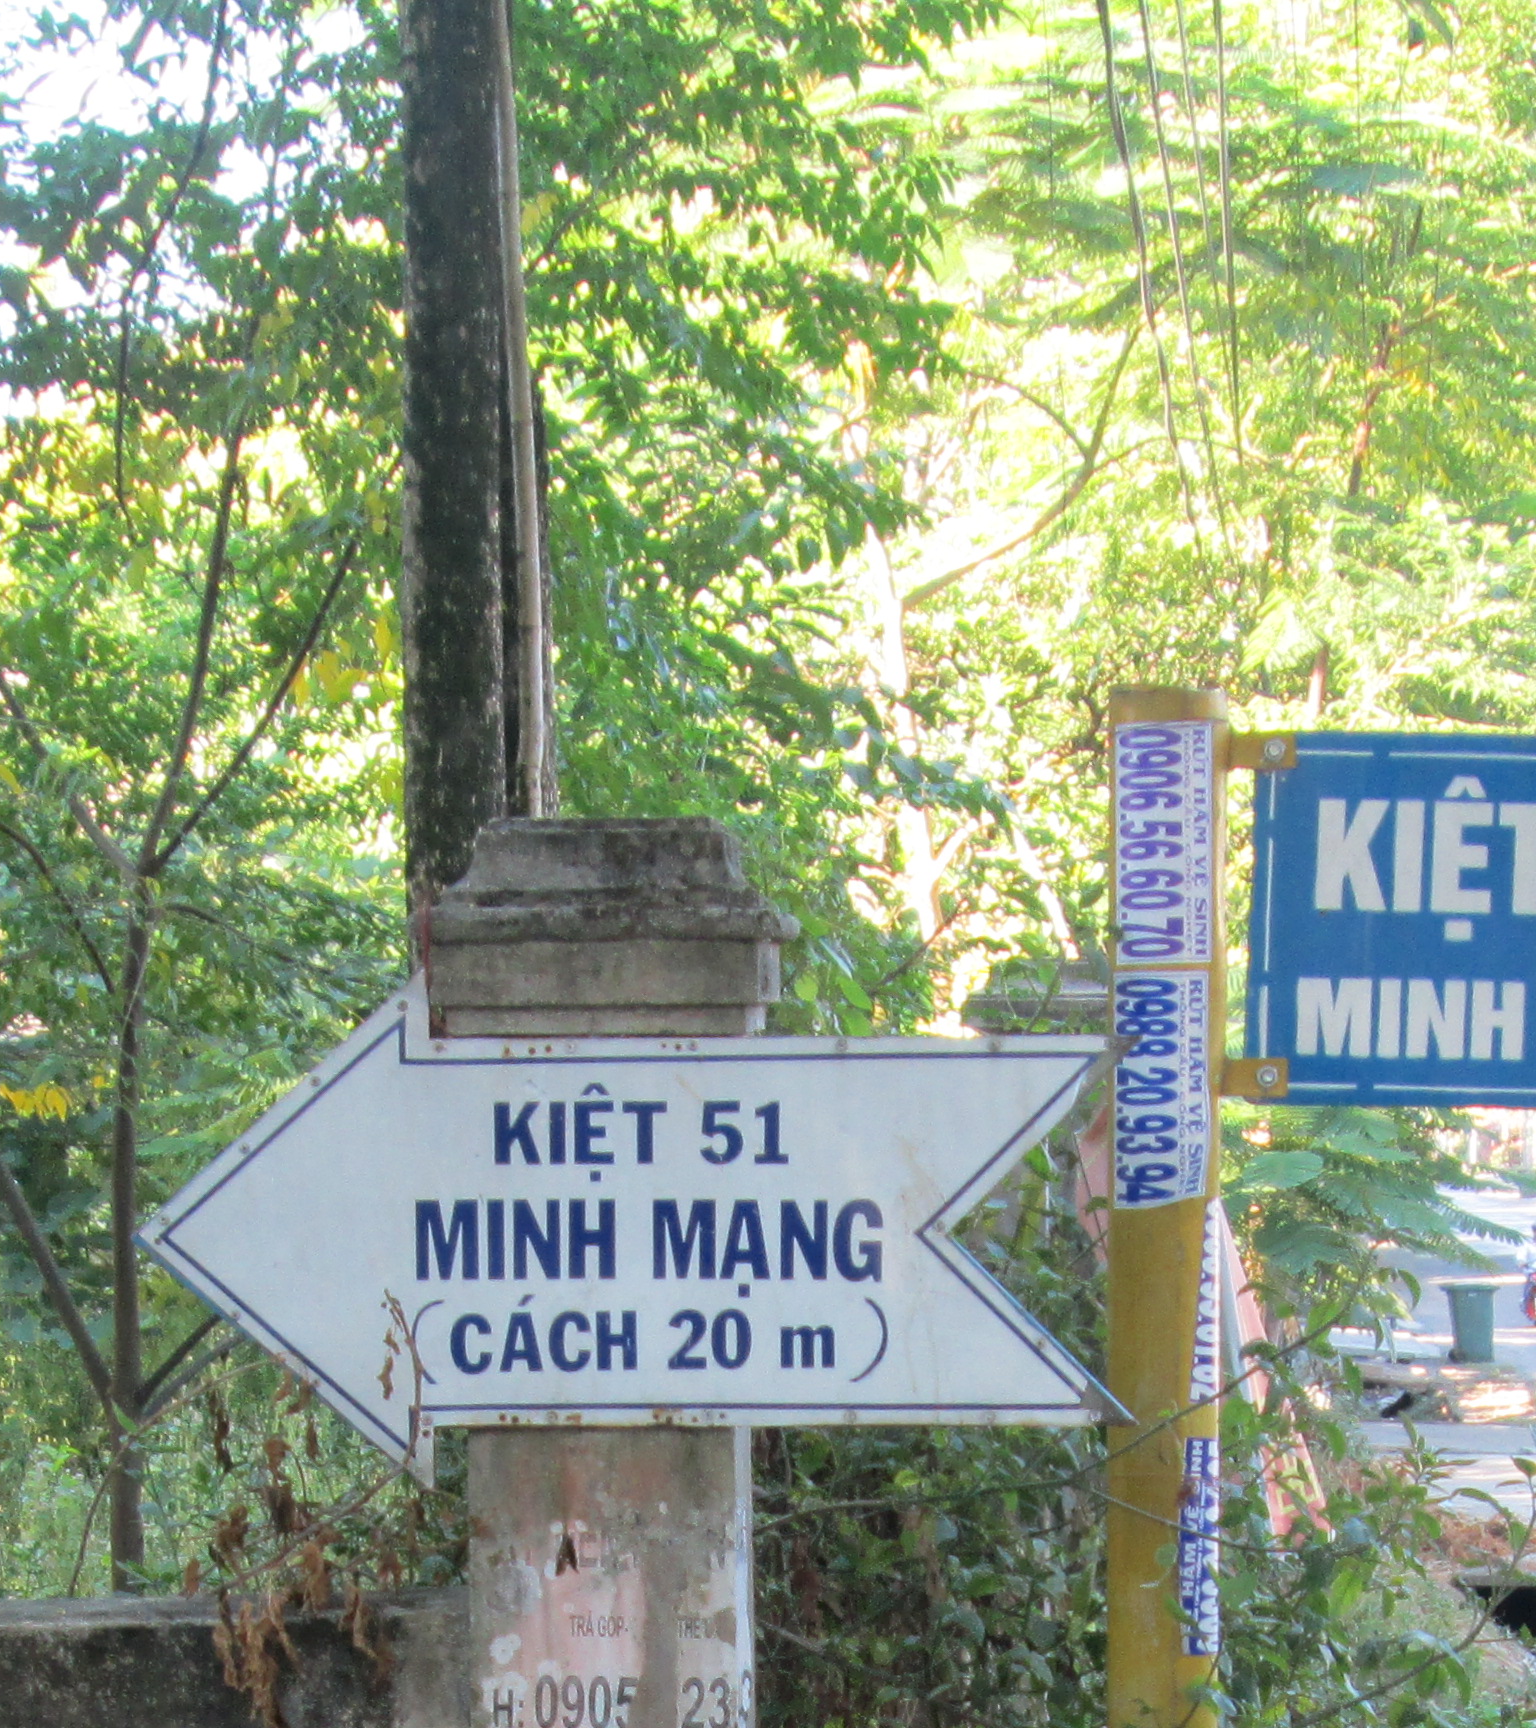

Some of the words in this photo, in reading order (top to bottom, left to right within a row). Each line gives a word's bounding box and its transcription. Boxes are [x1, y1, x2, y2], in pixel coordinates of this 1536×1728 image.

[1119, 728, 1184, 958] 0906.56.60.70
[1194, 898, 1208, 956] SINH
[1295, 977, 1526, 1061] MINH
[493, 1083, 667, 1182] KIỆT
[699, 1100, 790, 1165] 51
[415, 1200, 616, 1281] MINH
[652, 1198, 883, 1297] MẠNG
[667, 1307, 751, 1371] 20
